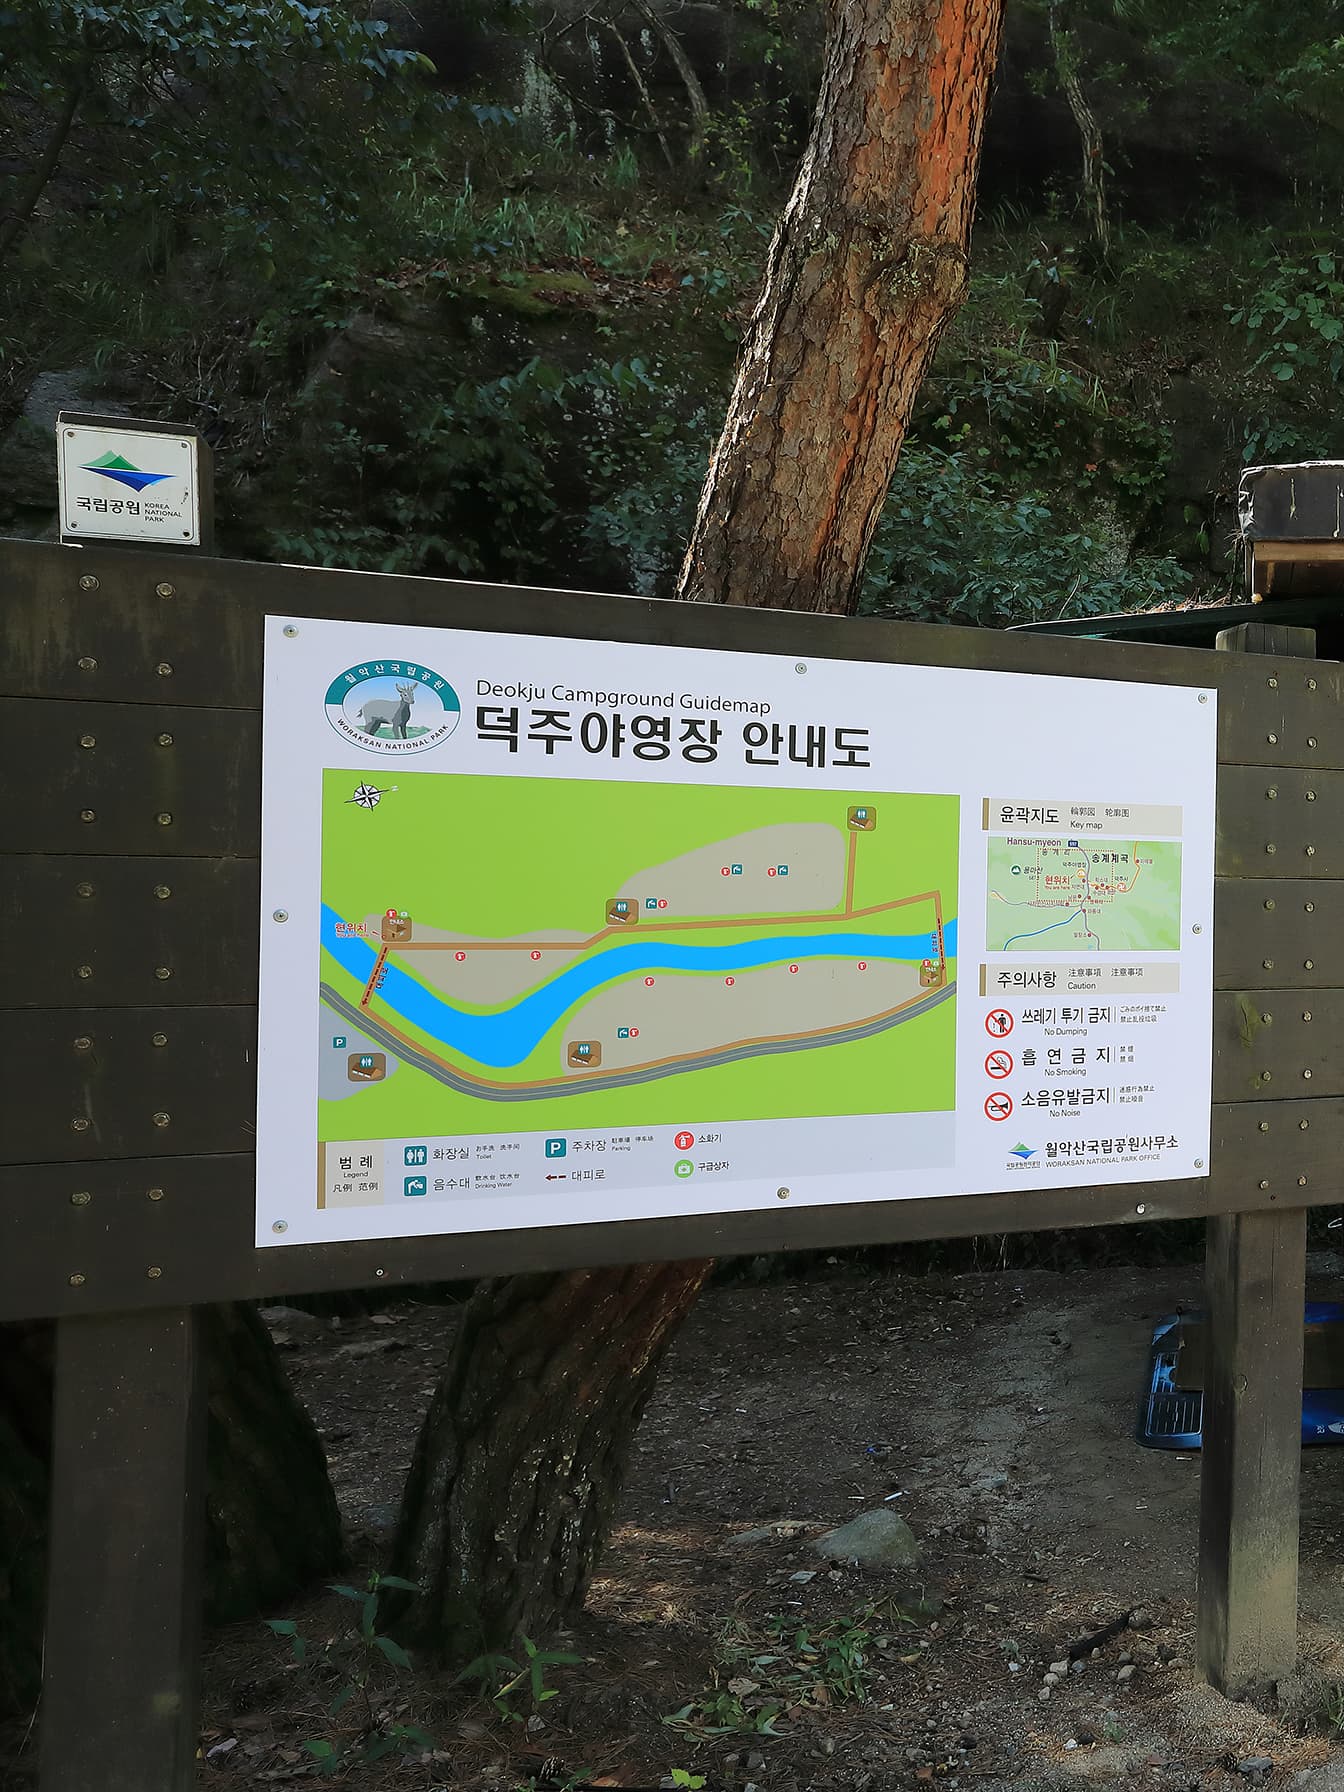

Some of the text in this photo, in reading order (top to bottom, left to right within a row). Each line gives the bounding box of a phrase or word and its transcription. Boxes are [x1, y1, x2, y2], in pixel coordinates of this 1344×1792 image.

[76, 497, 140, 515] 국립공원
[144, 502, 170, 510] KOREA
[144, 509, 182, 518] NATIONAL
[344, 663, 445, 690] 월악산국립공원
[476, 680, 771, 715] Deokju Campground Guidemap
[337, 718, 449, 750] WORAKSAN NATIONAL PARK
[476, 706, 872, 769] 덕주야영장 안내도
[1000, 806, 1059, 824] 윤곽지도
[1070, 820, 1103, 831] Key map
[1045, 875, 1070, 885] 현위치
[335, 922, 367, 933] 현위치
[997, 971, 1057, 988] 주의사항
[1067, 982, 1096, 990] Caution
[1021, 1006, 1111, 1024] 쓰레기 투기 금지
[1044, 1027, 1088, 1037] No Dumping
[1044, 1068, 1087, 1077] No Smoking
[1021, 1087, 1110, 1107] 소음유발금지
[1049, 1109, 1081, 1118] No Noise
[698, 1133, 723, 1144] 소화기
[572, 1140, 607, 1152] 주차장
[1044, 1134, 1179, 1158] 월악산국립공원사무소
[432, 1147, 470, 1161] 화장실
[1045, 1153, 1161, 1168] WORAKSAN NATIONAL PARK OFFICE
[698, 1161, 730, 1172] 구급상자
[343, 1171, 369, 1179] Legend
[571, 1169, 606, 1182] 대피로
[432, 1177, 470, 1191] 음수대
